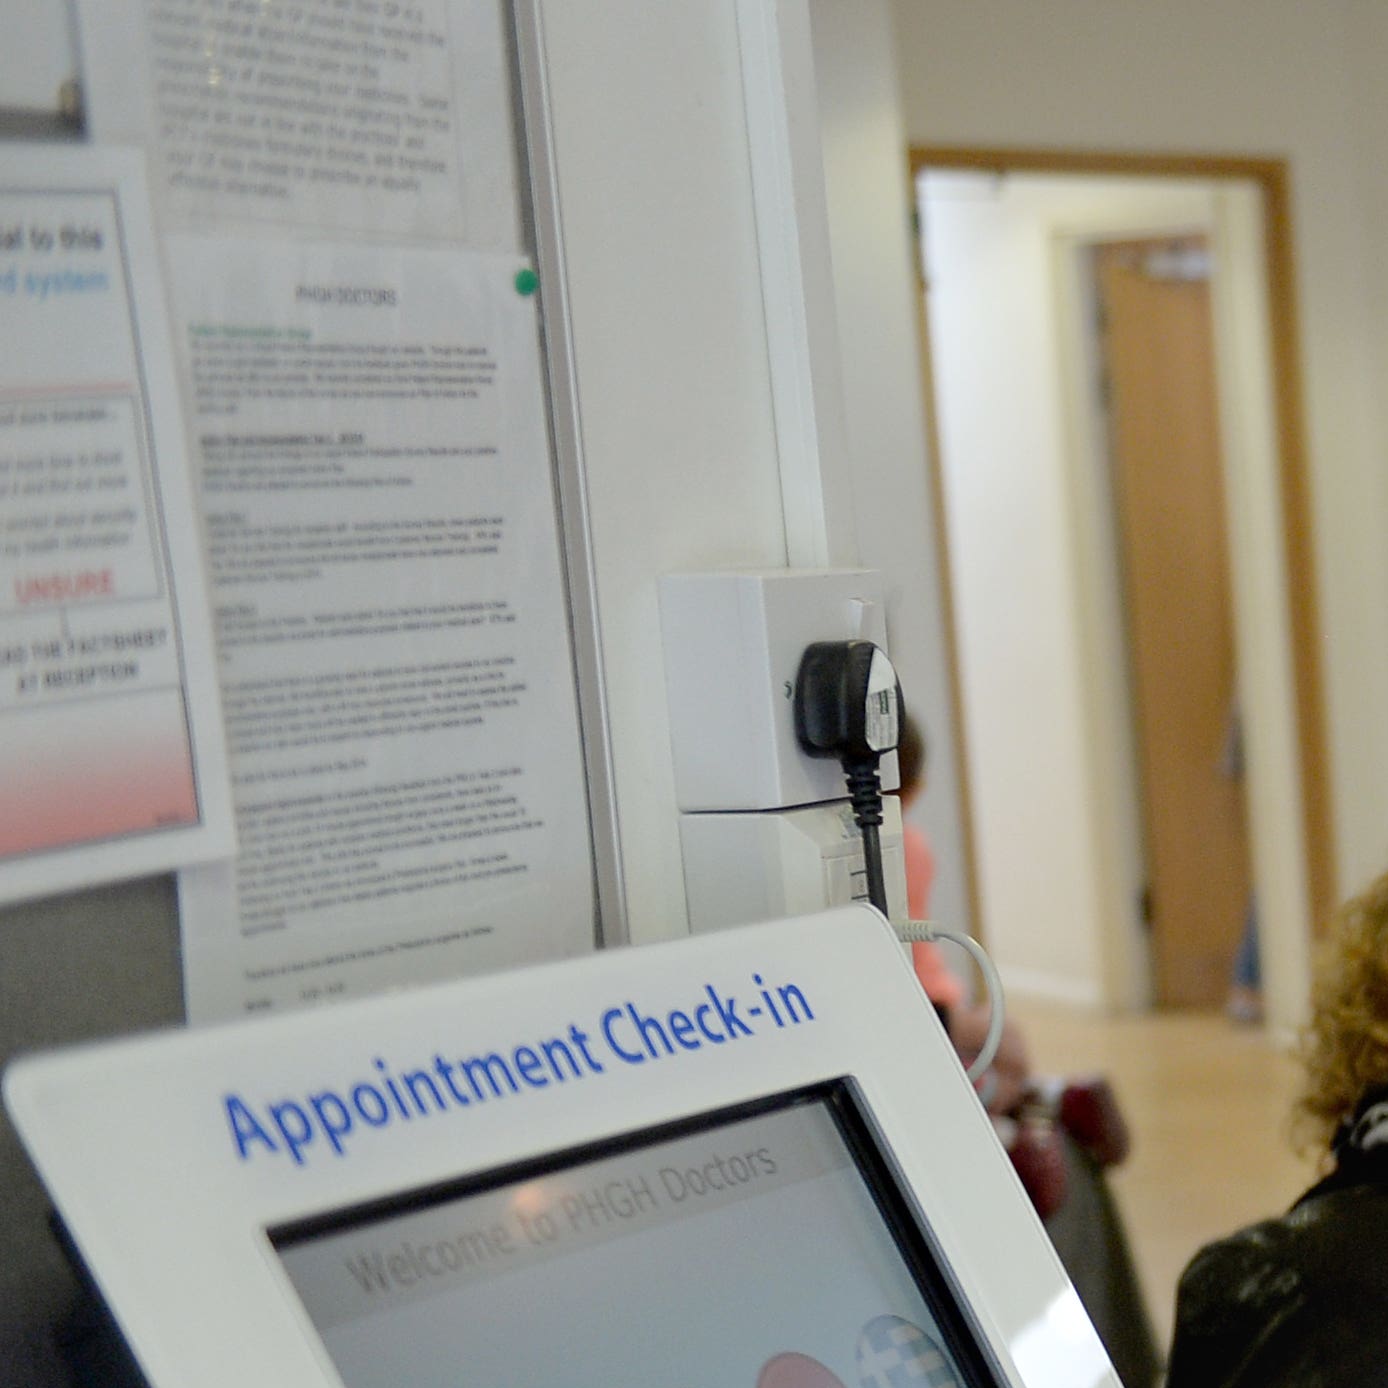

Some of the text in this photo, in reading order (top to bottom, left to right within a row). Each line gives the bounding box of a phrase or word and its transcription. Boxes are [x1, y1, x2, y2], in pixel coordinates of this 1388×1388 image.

[29, 225, 54, 252] to
[58, 222, 105, 251] this
[24, 266, 110, 303] system
[13, 569, 113, 605] UNSURE
[224, 972, 816, 1166] Appointment Check-in
[344, 1146, 778, 1296] Welcome to PHGH Doctors
